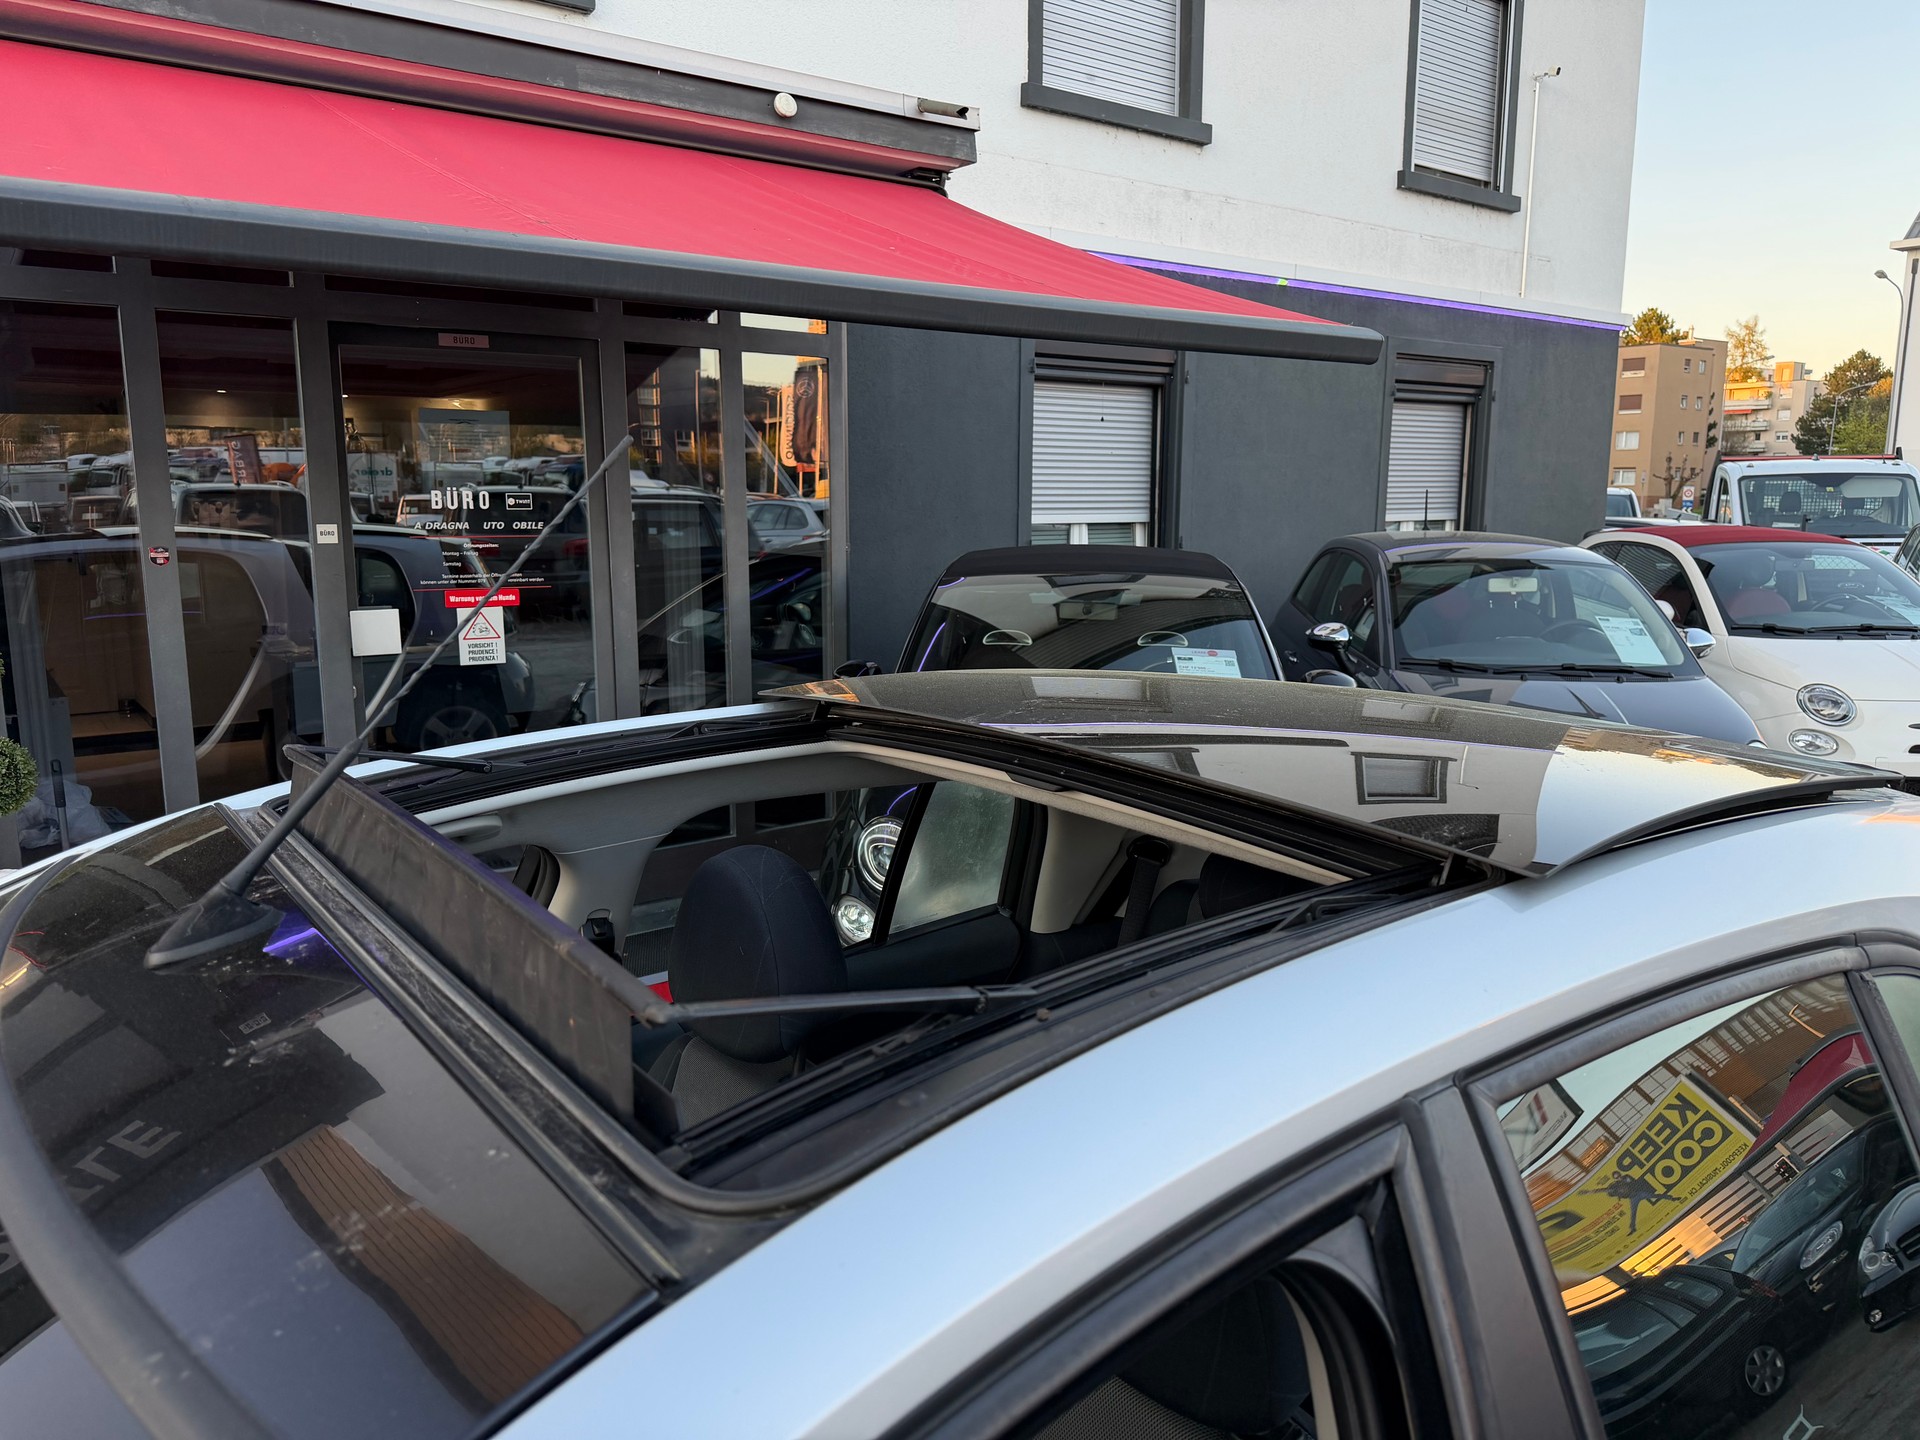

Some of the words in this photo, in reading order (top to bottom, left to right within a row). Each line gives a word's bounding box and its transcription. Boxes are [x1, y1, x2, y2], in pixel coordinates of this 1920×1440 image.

[430, 487, 490, 510] BÜRO
[425, 521, 470, 530] DRAGNA
[319, 529, 335, 537] BÜRO
[449, 595, 475, 603] Warnung
